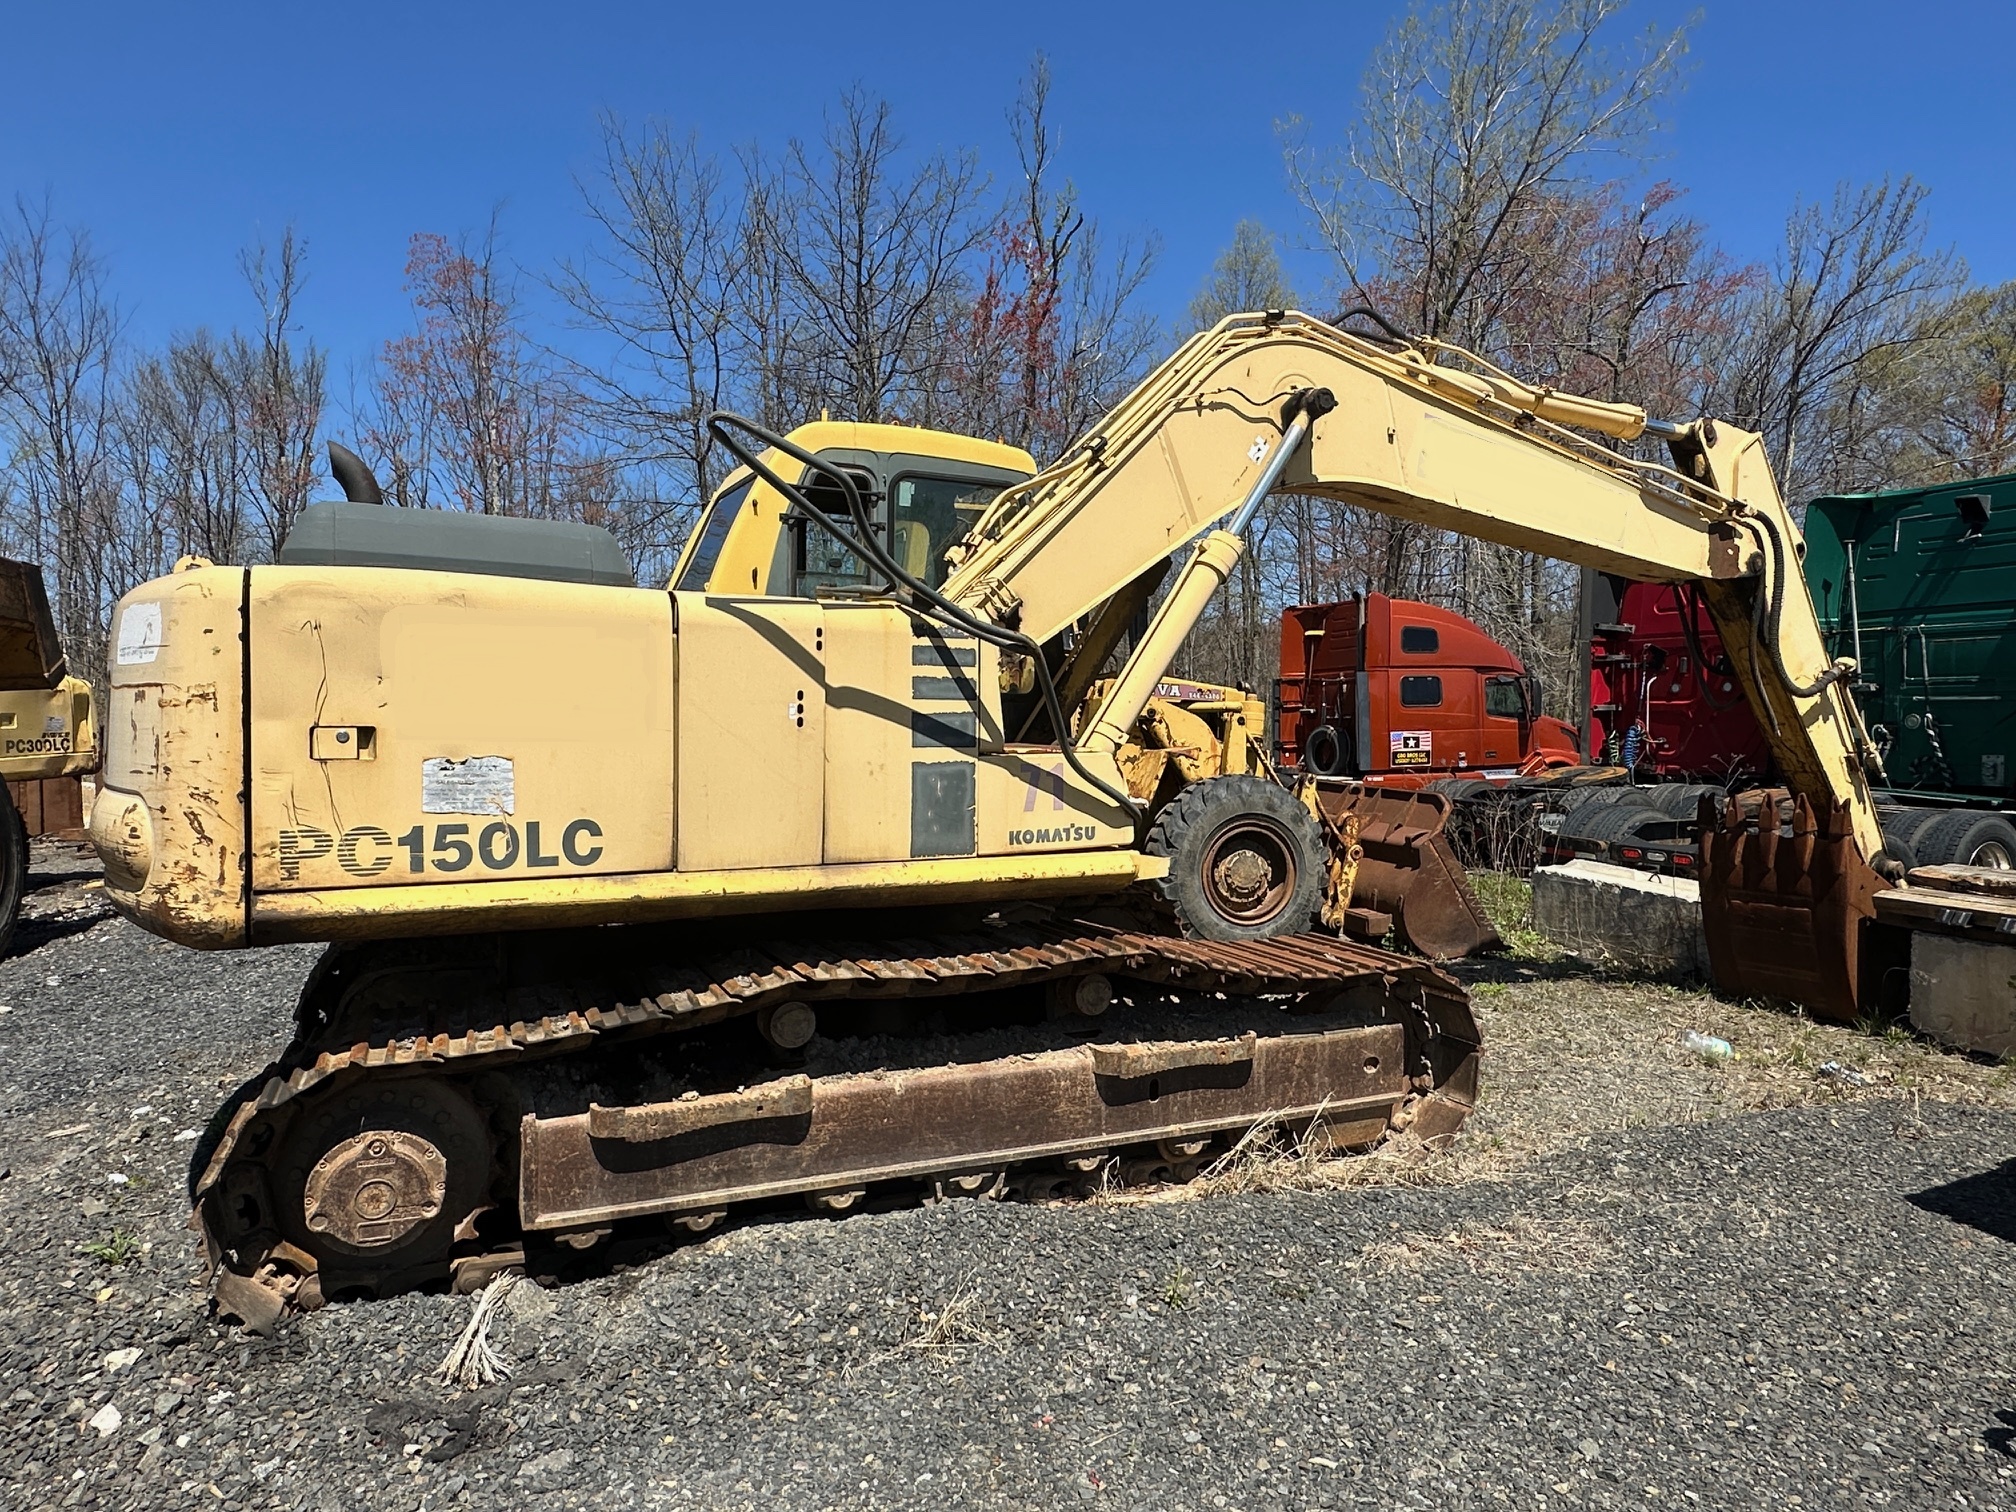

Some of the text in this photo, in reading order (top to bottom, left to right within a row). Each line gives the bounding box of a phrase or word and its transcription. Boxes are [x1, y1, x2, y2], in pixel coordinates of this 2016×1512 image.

[1152, 683, 1181, 697] VA
[6, 738, 71, 753] PC300LC
[1020, 763, 1064, 812] 71
[1009, 823, 1096, 846] KOMATSU
[279, 818, 604, 882] PC150LC
